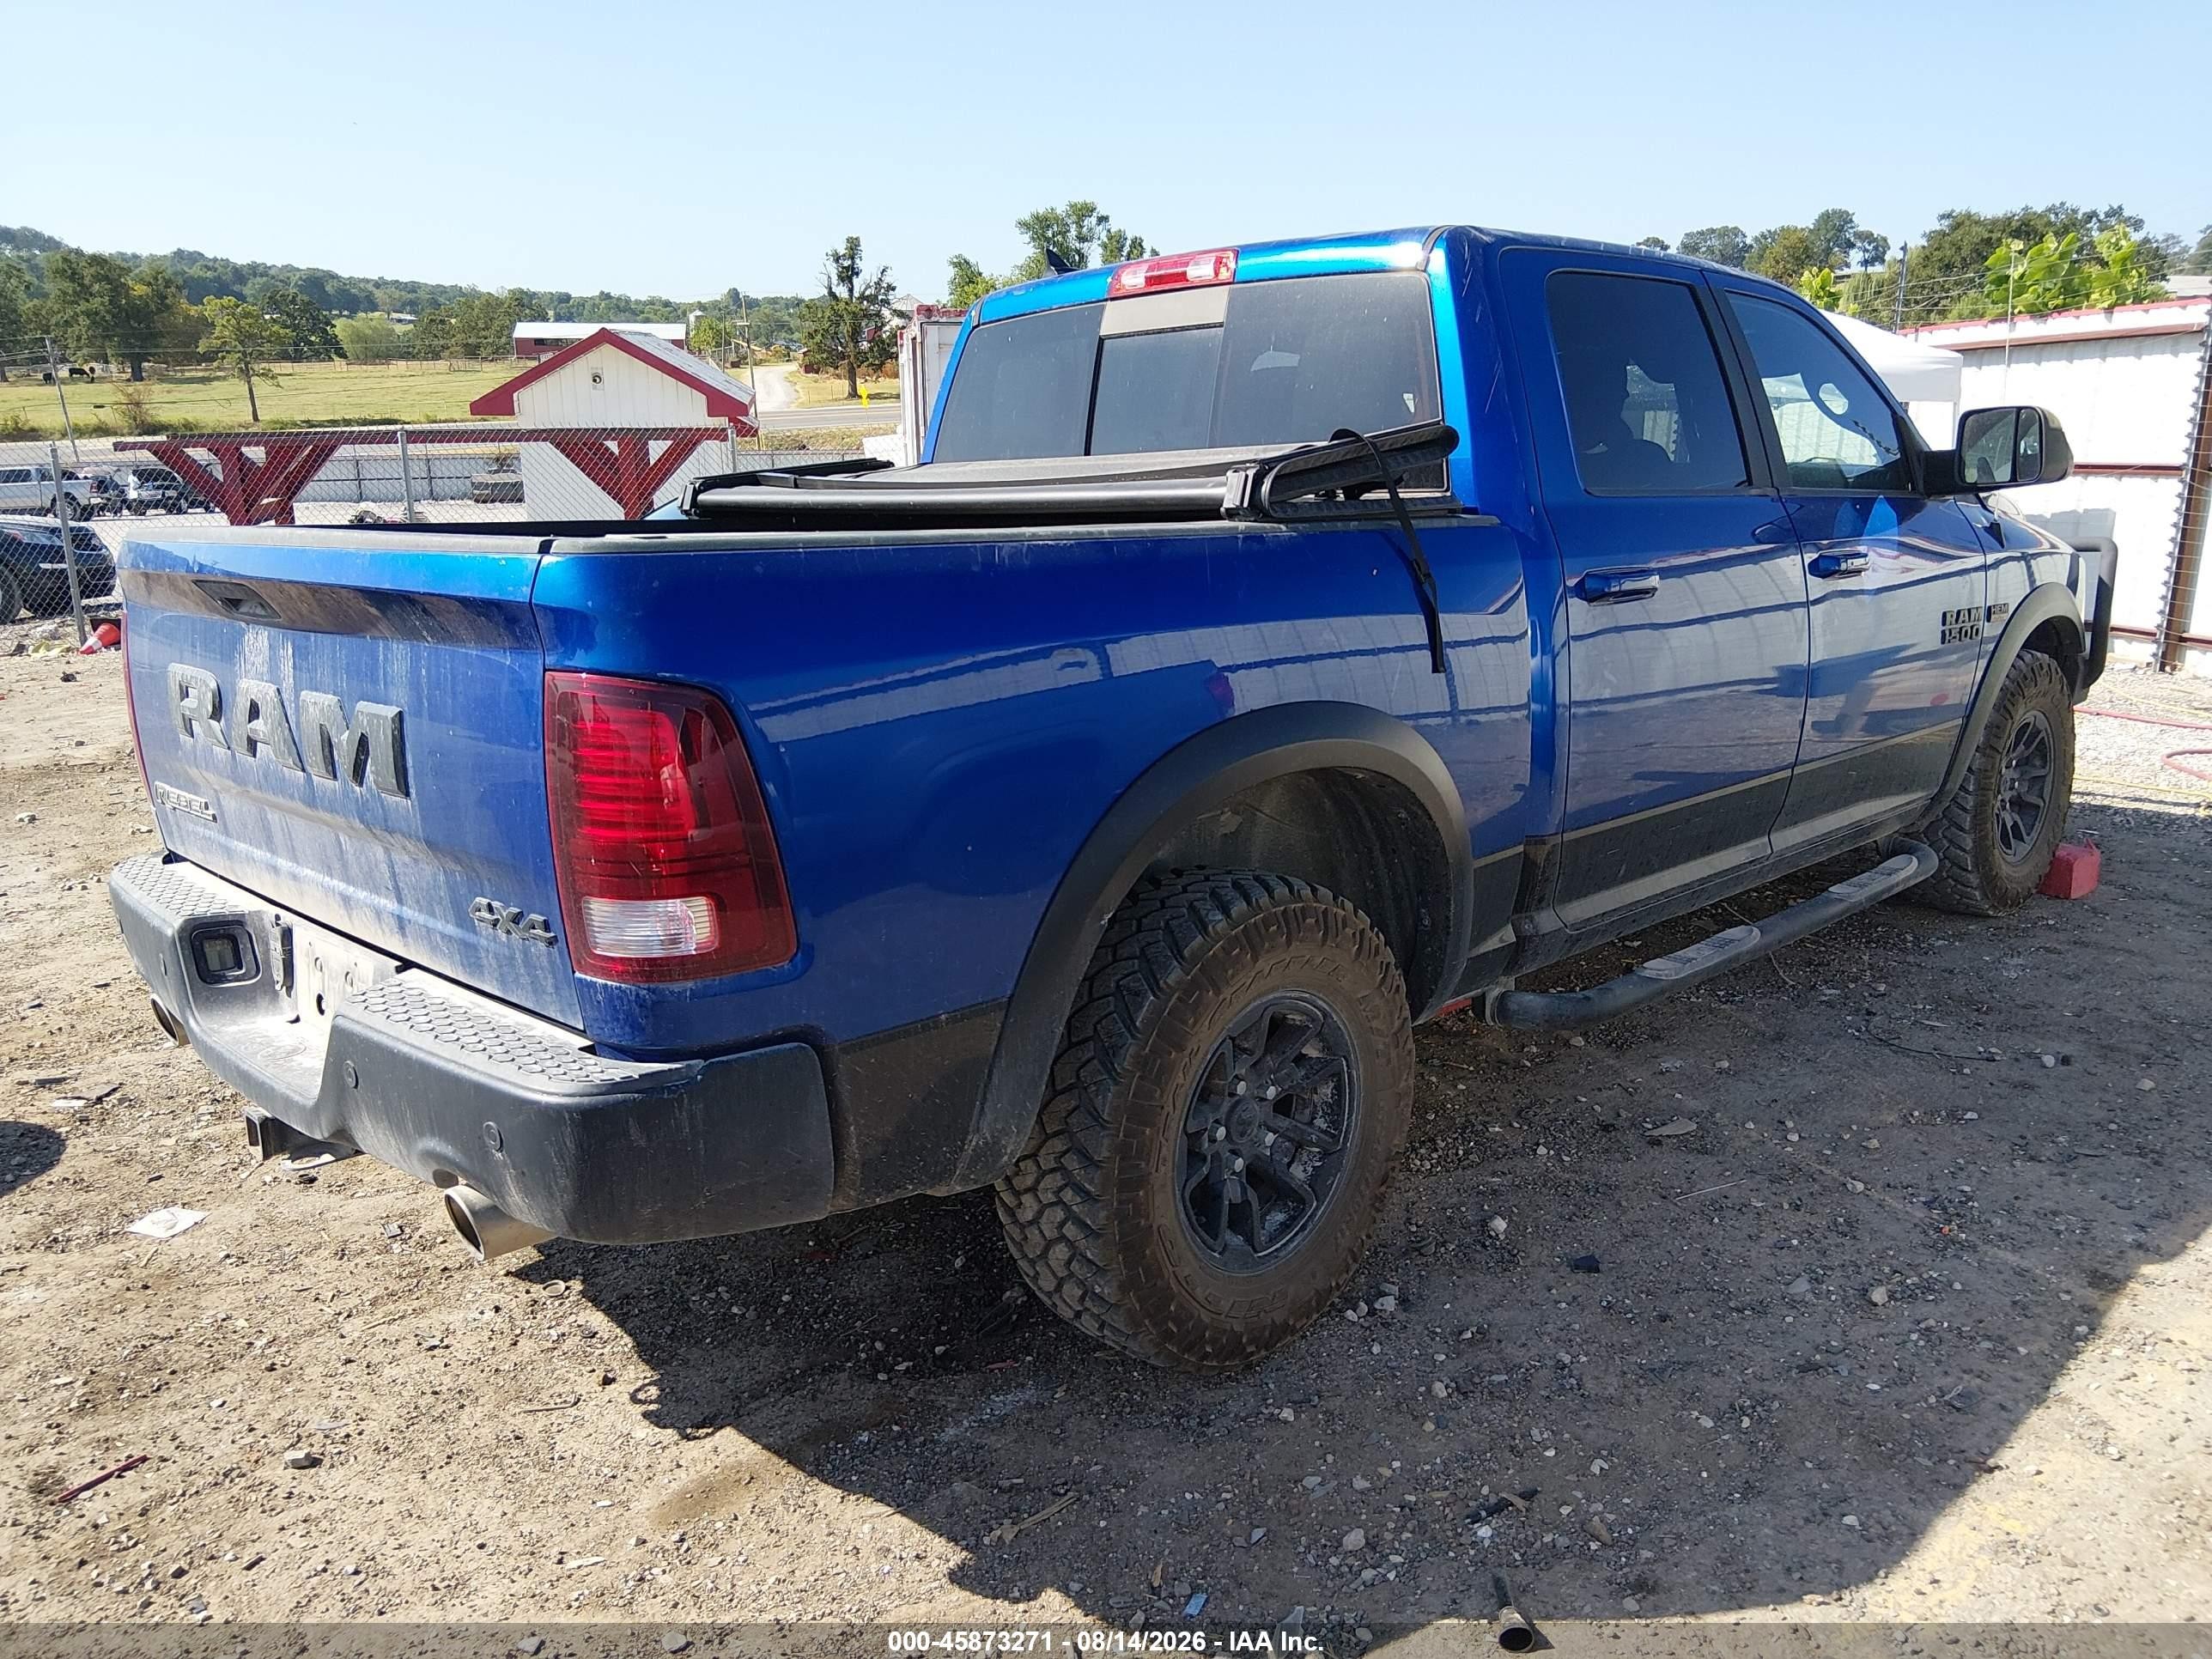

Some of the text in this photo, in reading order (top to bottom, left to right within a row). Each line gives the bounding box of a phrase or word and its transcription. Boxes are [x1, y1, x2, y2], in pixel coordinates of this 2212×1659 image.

[1942, 606, 1984, 626] RAM
[1941, 624, 1981, 645] 1500
[167, 662, 410, 799] RAM
[155, 781, 218, 823] REBEL
